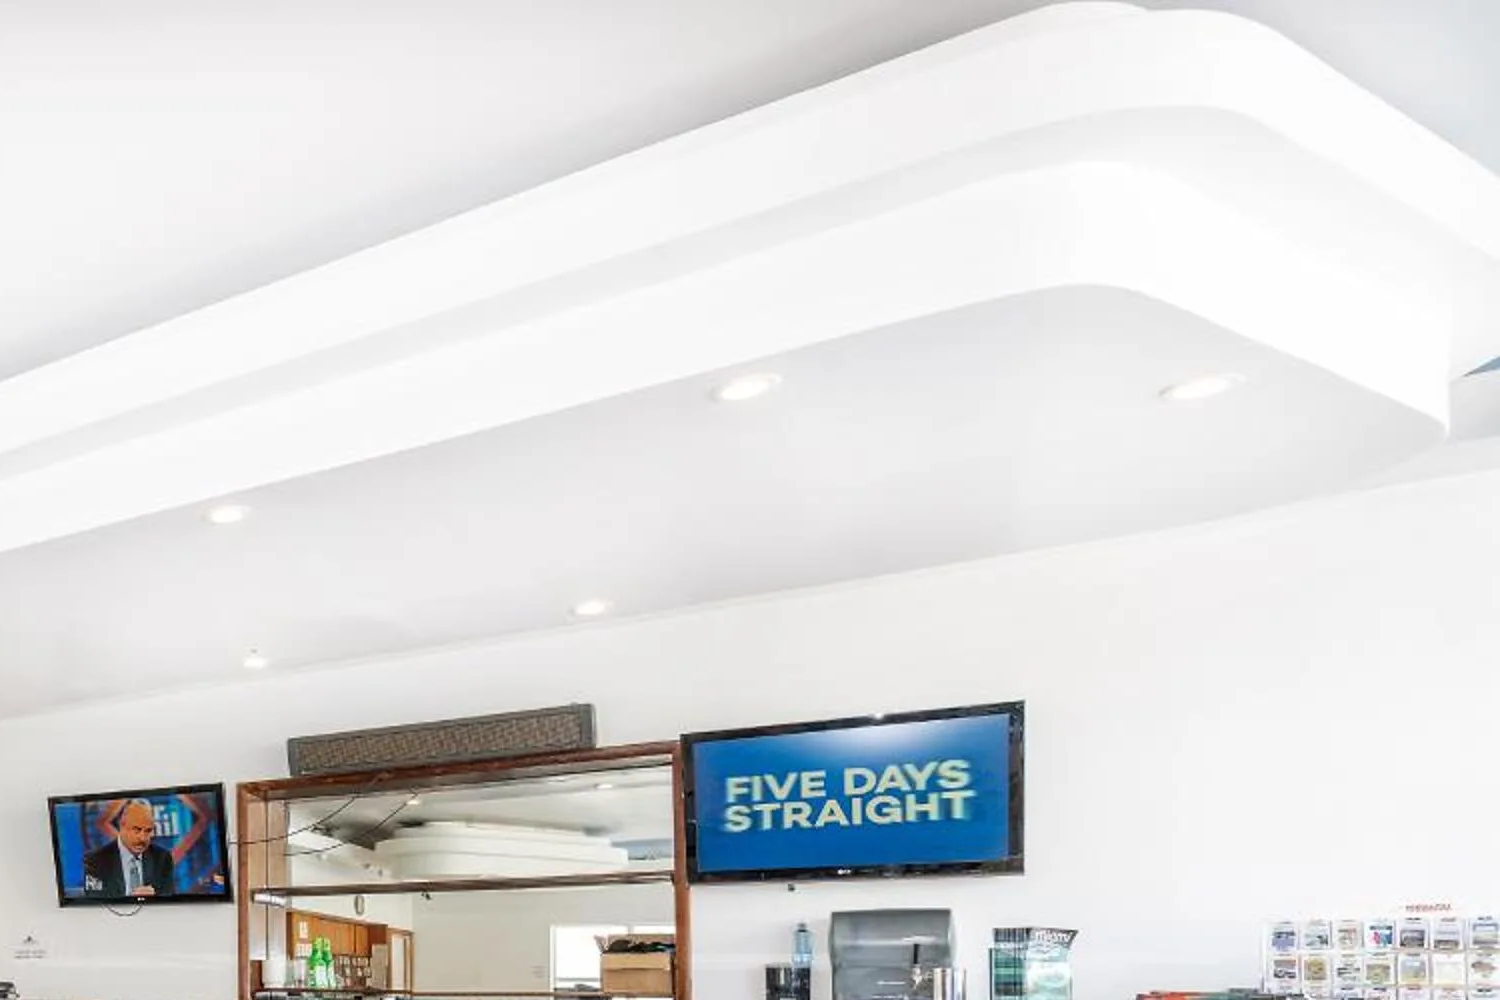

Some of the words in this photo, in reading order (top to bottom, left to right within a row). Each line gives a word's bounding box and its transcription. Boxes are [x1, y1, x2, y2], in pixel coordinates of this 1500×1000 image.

[725, 770, 826, 803] FIVE
[843, 759, 971, 796] DAYS
[723, 790, 977, 833] STRAIGHT
